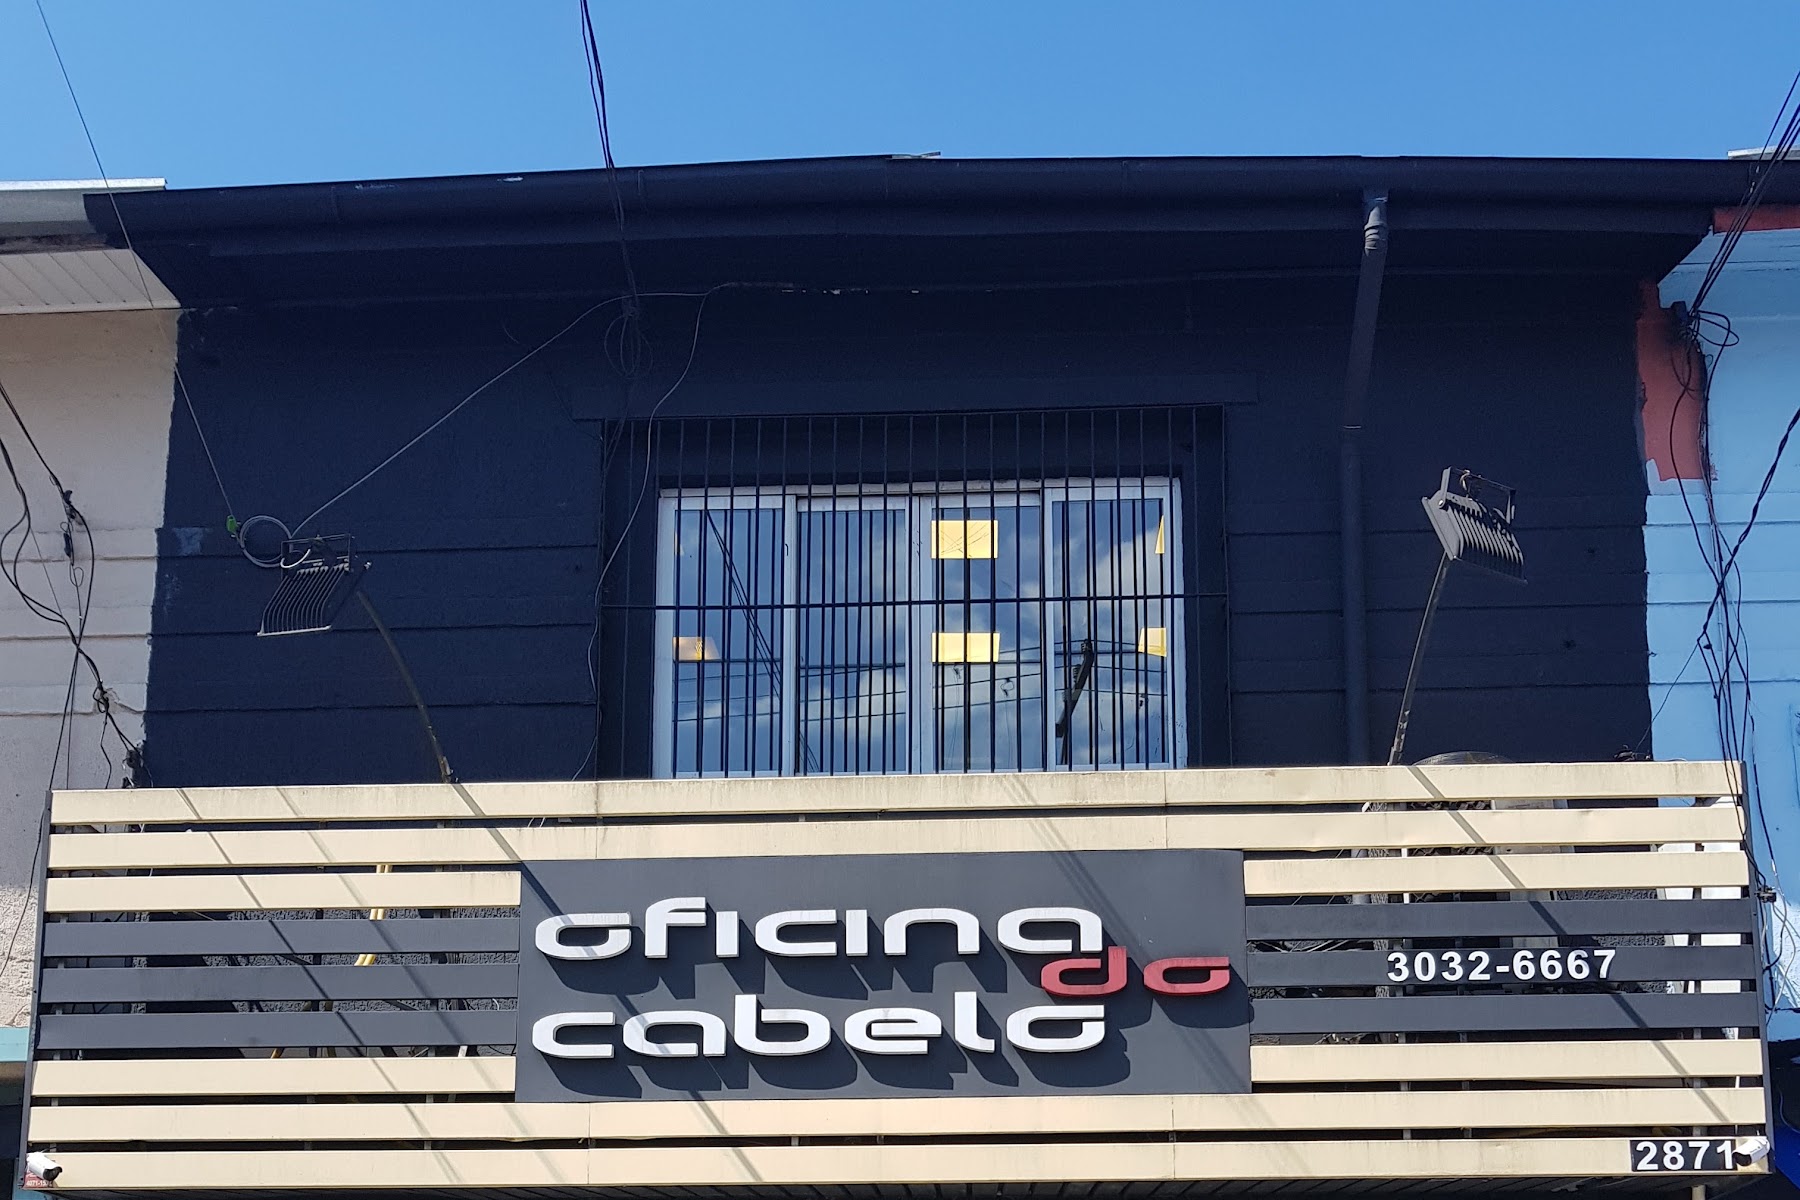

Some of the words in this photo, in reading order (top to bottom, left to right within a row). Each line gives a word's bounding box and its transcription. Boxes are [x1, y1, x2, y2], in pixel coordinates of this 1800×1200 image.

[535, 897, 1102, 960] oficina
[1040, 946, 1230, 997] do
[1387, 949, 1616, 982] 3032-6667
[532, 991, 1106, 1059] cabelo
[1636, 1140, 1733, 1171] 2871
